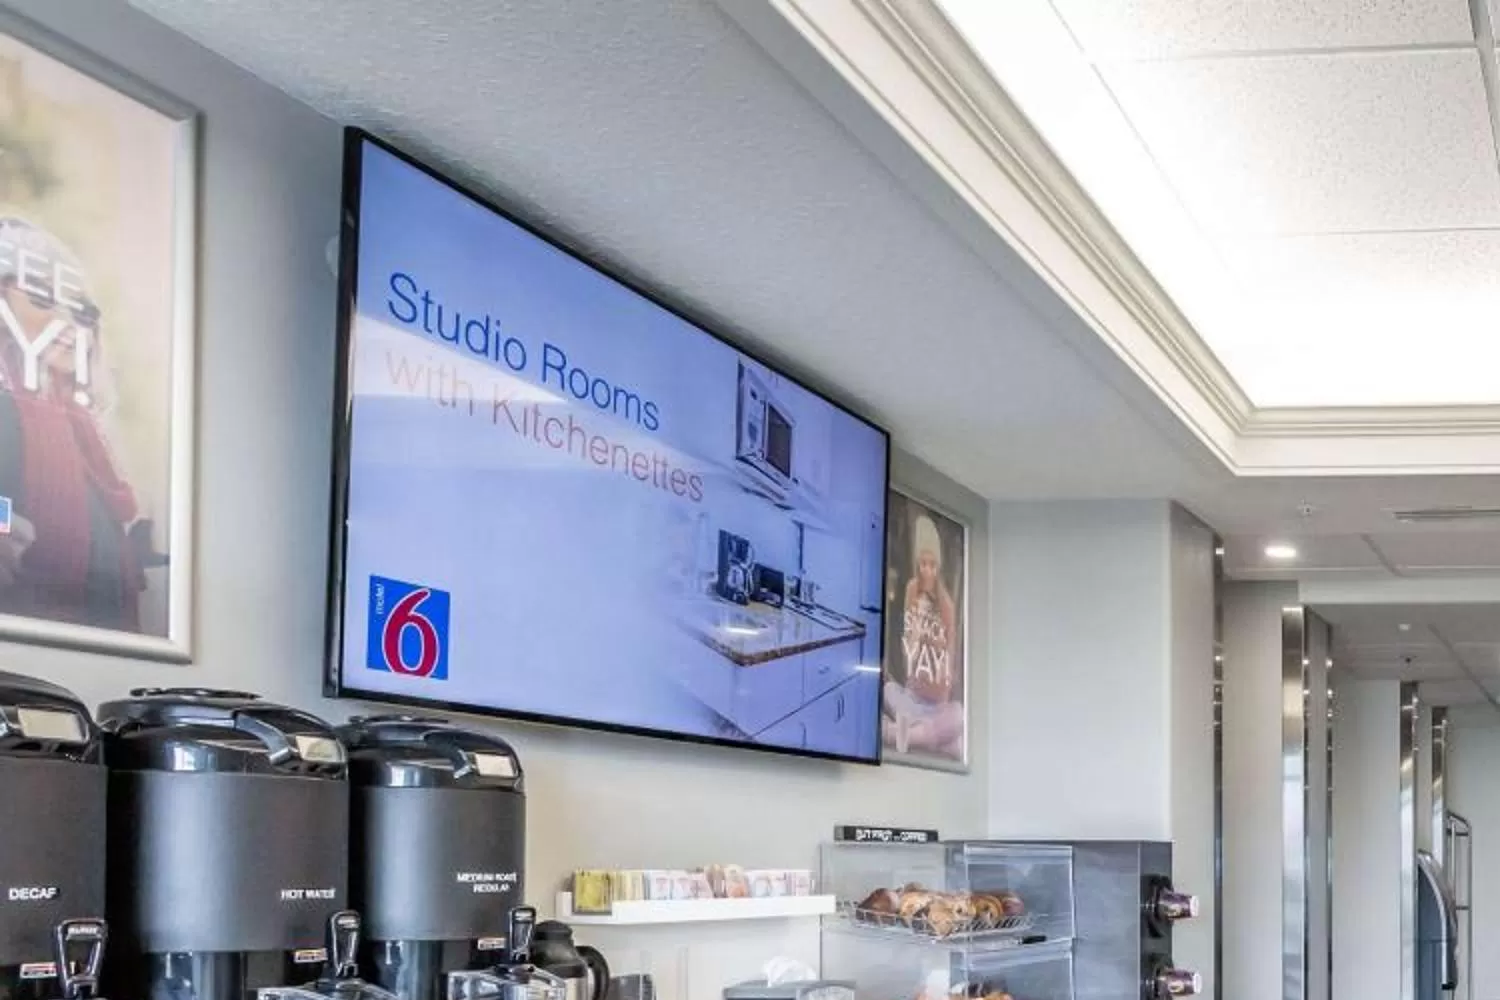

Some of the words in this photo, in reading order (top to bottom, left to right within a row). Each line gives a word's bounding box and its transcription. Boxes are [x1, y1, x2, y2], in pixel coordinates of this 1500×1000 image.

[387, 271, 528, 371] Studio
[541, 341, 661, 432] Rooms
[385, 349, 474, 417] with
[492, 383, 705, 504] Kitchenettes
[382, 587, 441, 680] 6
[901, 636, 951, 687] YAY!
[9, 887, 57, 900] DECAF
[281, 888, 304, 899] HOT
